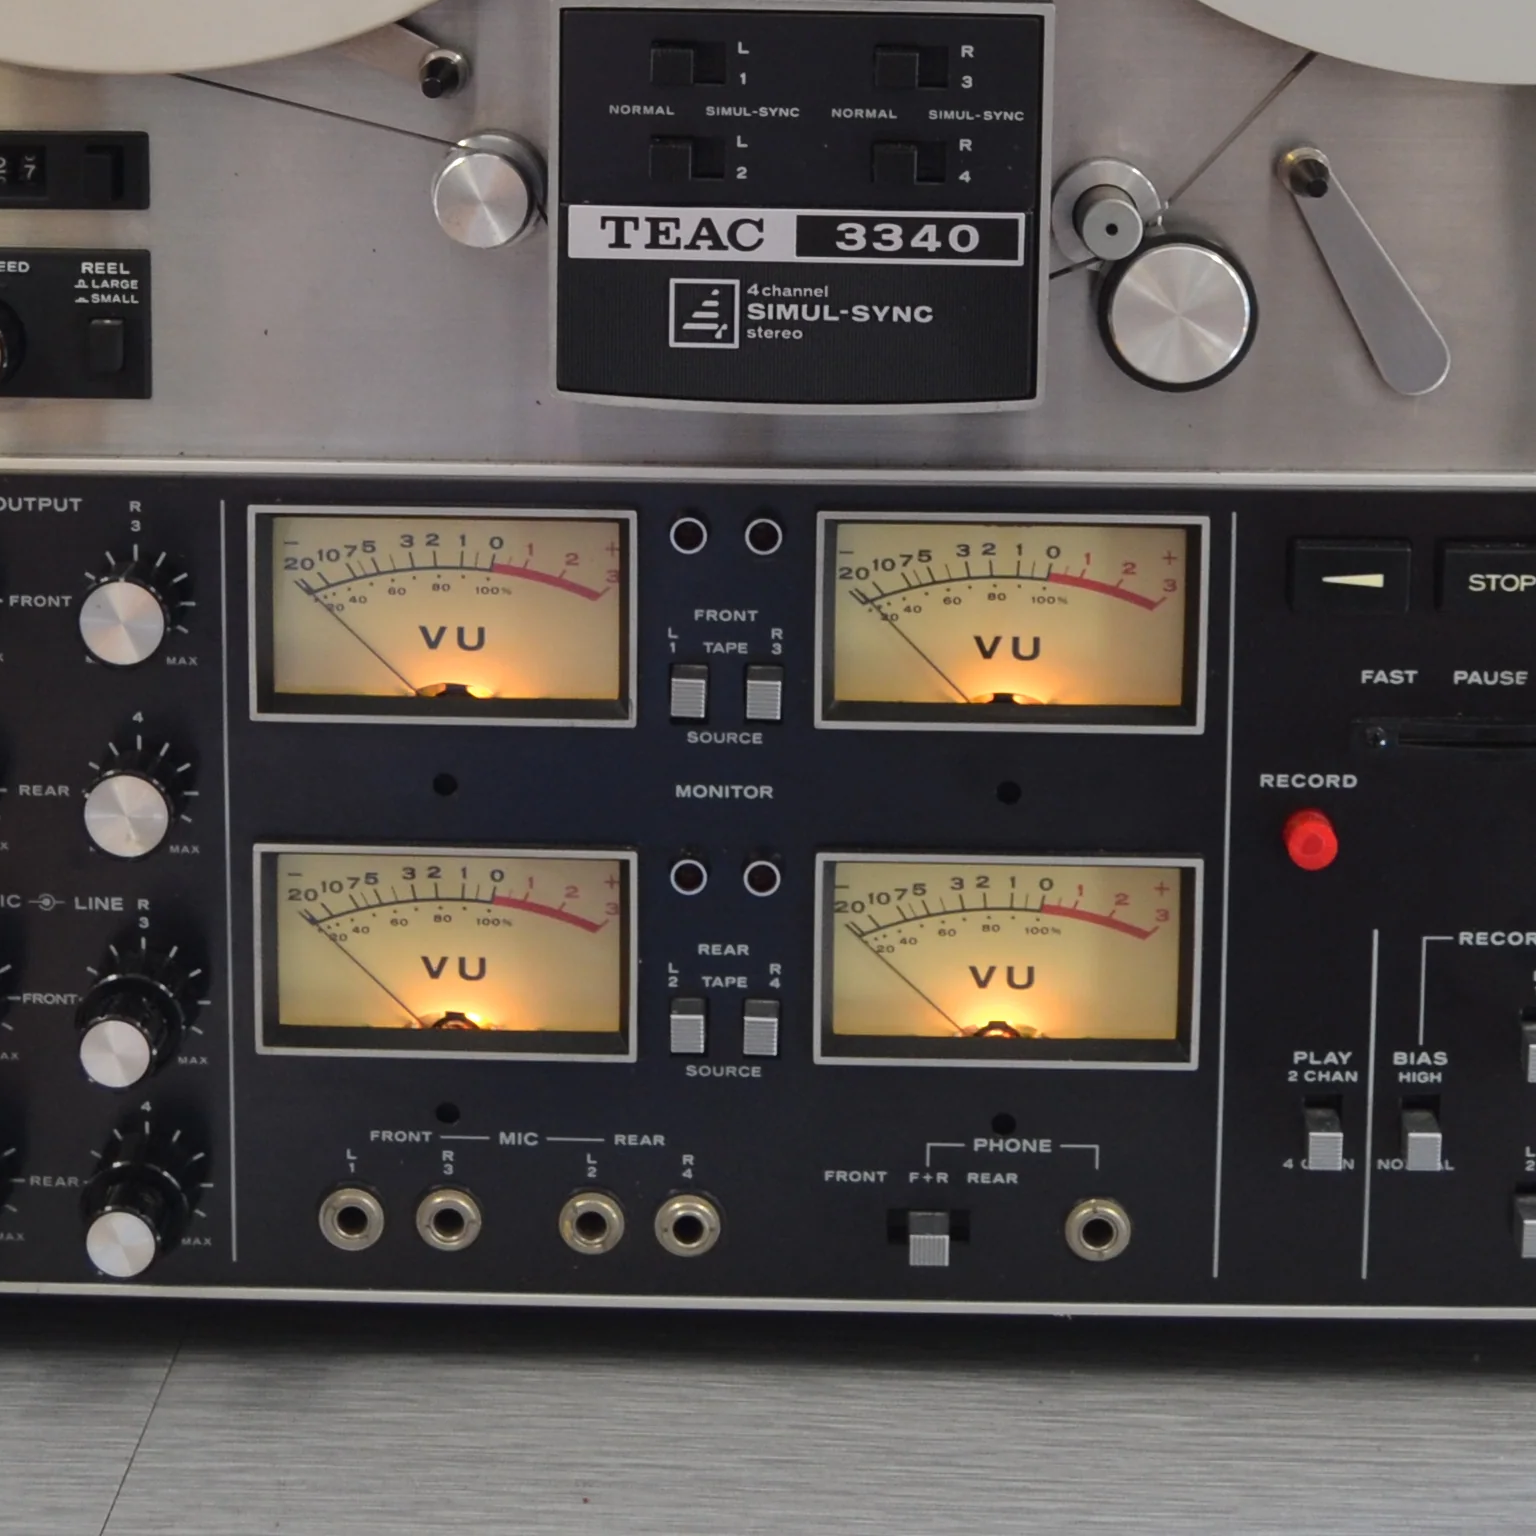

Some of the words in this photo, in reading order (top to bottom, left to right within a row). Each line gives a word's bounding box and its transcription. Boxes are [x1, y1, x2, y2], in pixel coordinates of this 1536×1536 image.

[737, 42, 750, 55] L
[961, 45, 975, 59] R
[739, 73, 747, 86] 1
[961, 76, 974, 89] 3
[609, 104, 675, 116] NORMAL
[705, 106, 801, 119] SIMUL-SYNC
[831, 108, 898, 120] NORMAL
[928, 109, 1025, 122] SIMUL-SYNC
[736, 136, 749, 149] L
[959, 139, 973, 152] R
[736, 167, 748, 180] 2
[958, 170, 972, 184] 4
[600, 215, 765, 252] TEAC
[835, 222, 981, 253] 3340
[81, 262, 131, 275] REEL
[91, 279, 139, 290] LARGE
[91, 294, 139, 304] SMALL
[747, 303, 934, 323] SIMUL-SYNC
[746, 326, 803, 340] stereo
[129, 501, 142, 513] R
[131, 520, 142, 532] 3
[284, 557, 314, 571] 20
[317, 548, 340, 562] 10
[344, 545, 358, 558] 7
[362, 540, 376, 554] 5
[400, 534, 414, 548] 3
[425, 533, 439, 547] 2
[490, 536, 504, 550] 0
[838, 567, 870, 581] 20
[872, 558, 896, 572] 10
[1468, 573, 1536, 592] STOP
[9, 595, 72, 607] FRONT
[694, 609, 759, 622] FRONT
[668, 627, 679, 639] L
[771, 628, 783, 640] R
[703, 642, 748, 654] TAPE
[772, 643, 782, 655] 3
[166, 656, 198, 666] MAX
[1361, 669, 1419, 684] FAST
[1453, 670, 1529, 686] PAUSE
[687, 731, 763, 745] SOURCE
[1260, 773, 1358, 789] RECORD
[19, 785, 70, 797] REAR
[675, 784, 774, 799] MONITOR
[170, 845, 200, 854] MAX
[74, 897, 124, 911] LINE
[698, 944, 750, 956] REAR
[702, 976, 748, 988] TAPE
[23, 993, 77, 1005] FRONT
[177, 1056, 208, 1065] MAX
[1293, 1051, 1353, 1065] PLAY
[1393, 1051, 1448, 1066] BIAS
[686, 1065, 762, 1078] SOURCE
[1304, 1070, 1358, 1082] CHAN
[1398, 1071, 1442, 1083] HIGH
[370, 1130, 433, 1143] FRONT
[499, 1132, 539, 1146] MIC
[614, 1134, 665, 1146] REAR
[973, 1138, 1052, 1153] PHONE
[30, 1176, 79, 1187] REAR
[824, 1170, 888, 1182] FRONT
[967, 1172, 1018, 1184] REAR
[181, 1237, 212, 1246] MAX
